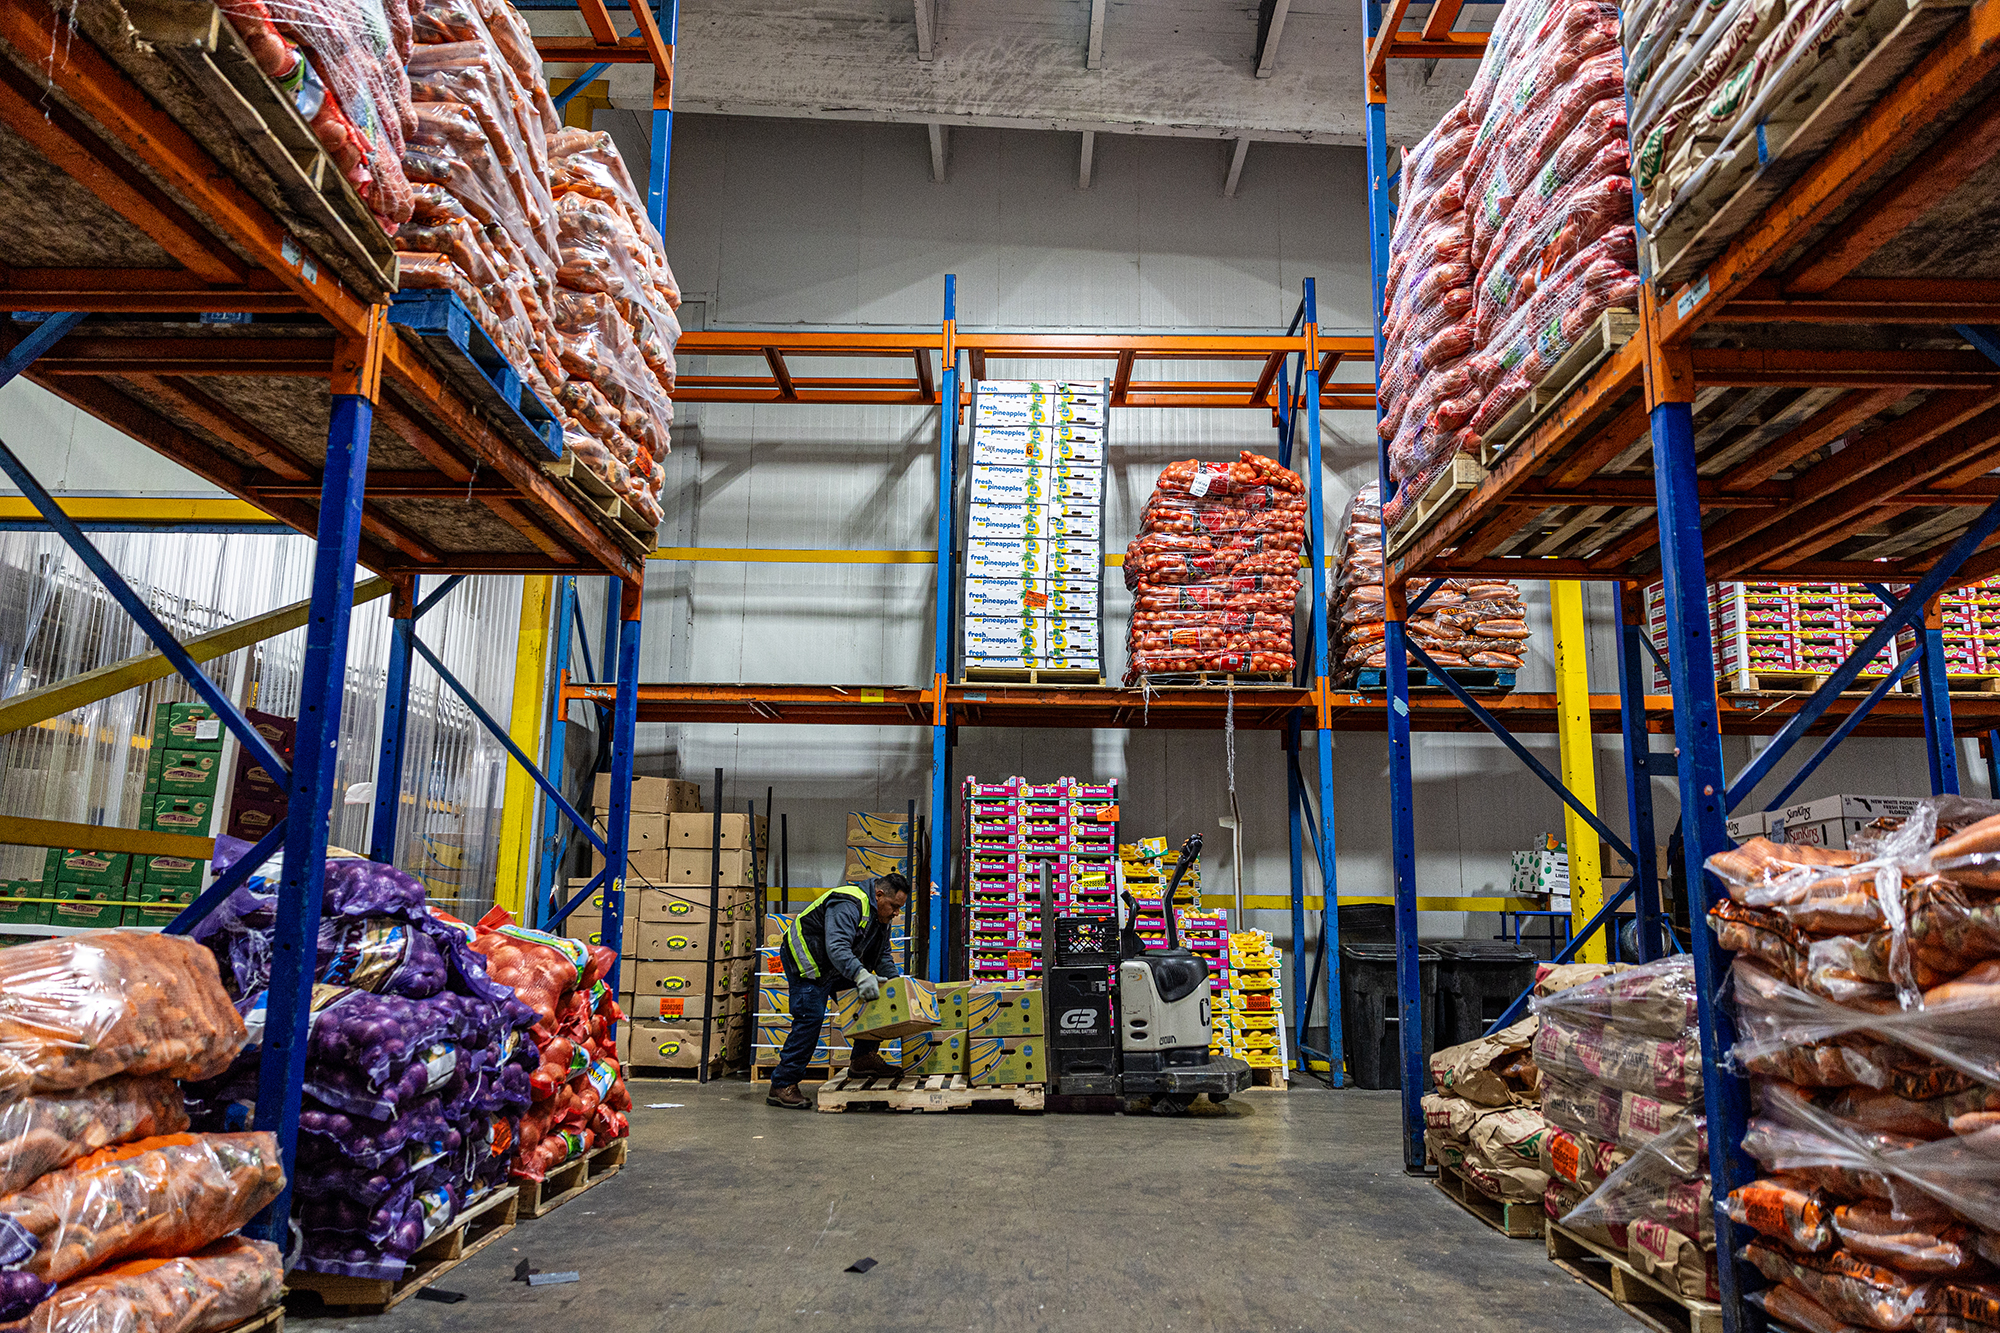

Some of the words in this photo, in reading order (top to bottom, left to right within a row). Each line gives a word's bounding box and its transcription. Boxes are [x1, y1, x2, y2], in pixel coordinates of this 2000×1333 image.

[990, 447, 1025, 455] neapples
[1026, 445, 1033, 455] 6
[988, 465, 1023, 473] pineapples
[987, 485, 1023, 493] pineapples
[985, 541, 1021, 549] pineapples
[983, 560, 1020, 568] pineapples
[982, 579, 1018, 587] pineapples
[982, 598, 1018, 606] pineapples
[982, 617, 1018, 625] pineapples
[981, 637, 1017, 645] pineapples
[1785, 806, 1811, 823] SunKing
[1789, 826, 1820, 844] SunKing
